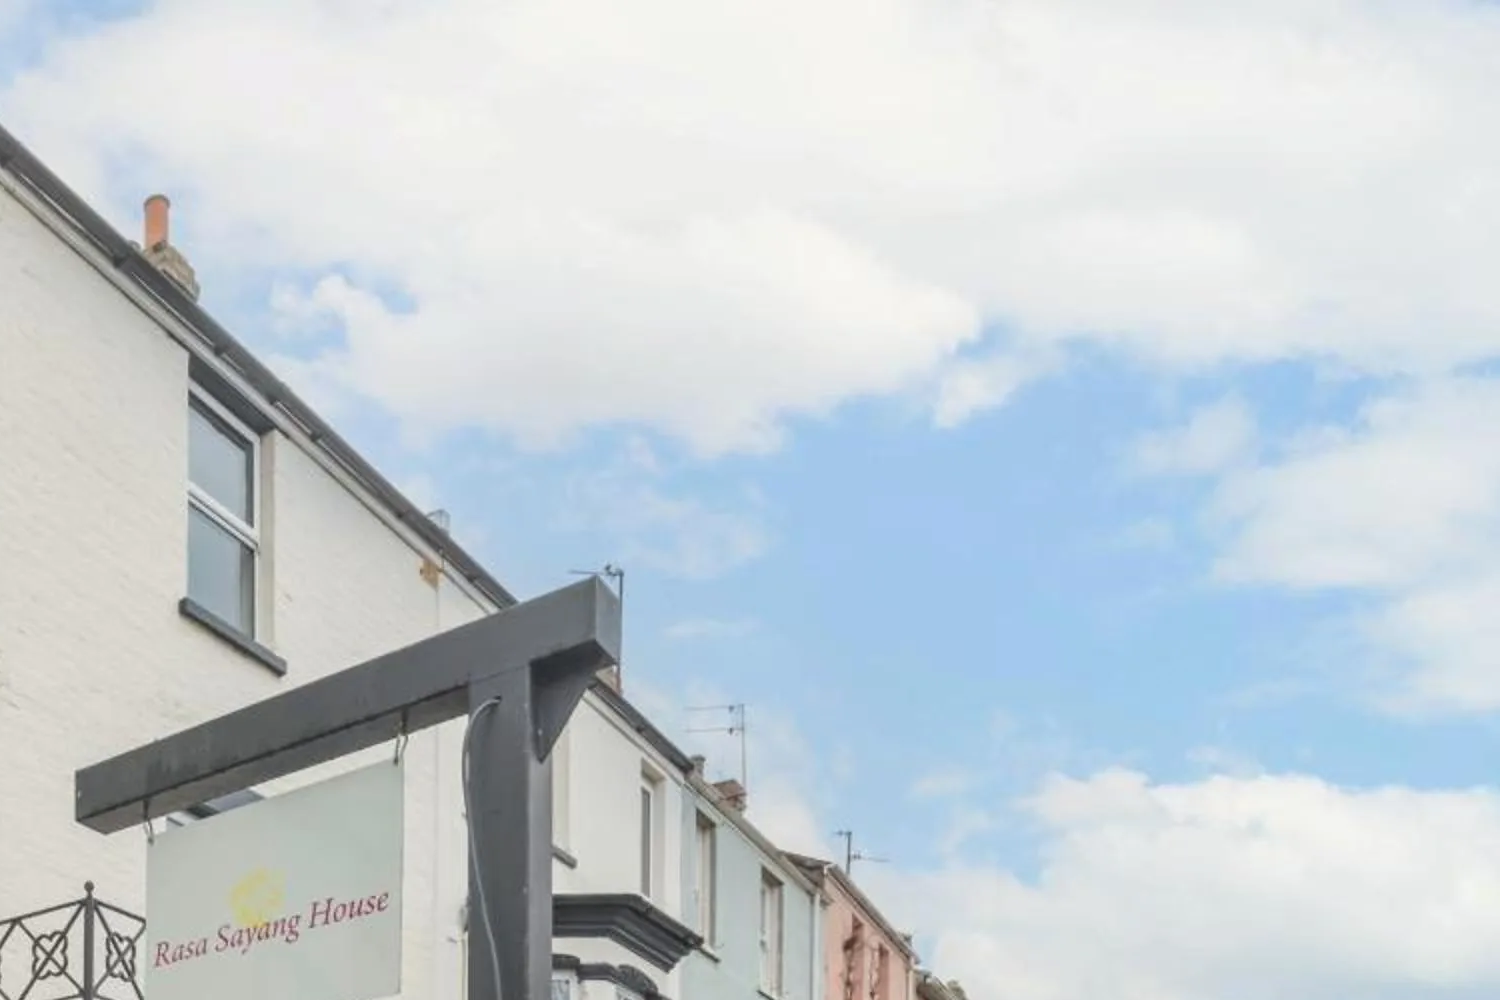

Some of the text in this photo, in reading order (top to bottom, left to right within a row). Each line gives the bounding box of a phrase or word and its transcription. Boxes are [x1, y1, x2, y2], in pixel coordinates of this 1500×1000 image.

[153, 891, 390, 968] Rasa Sayang House
